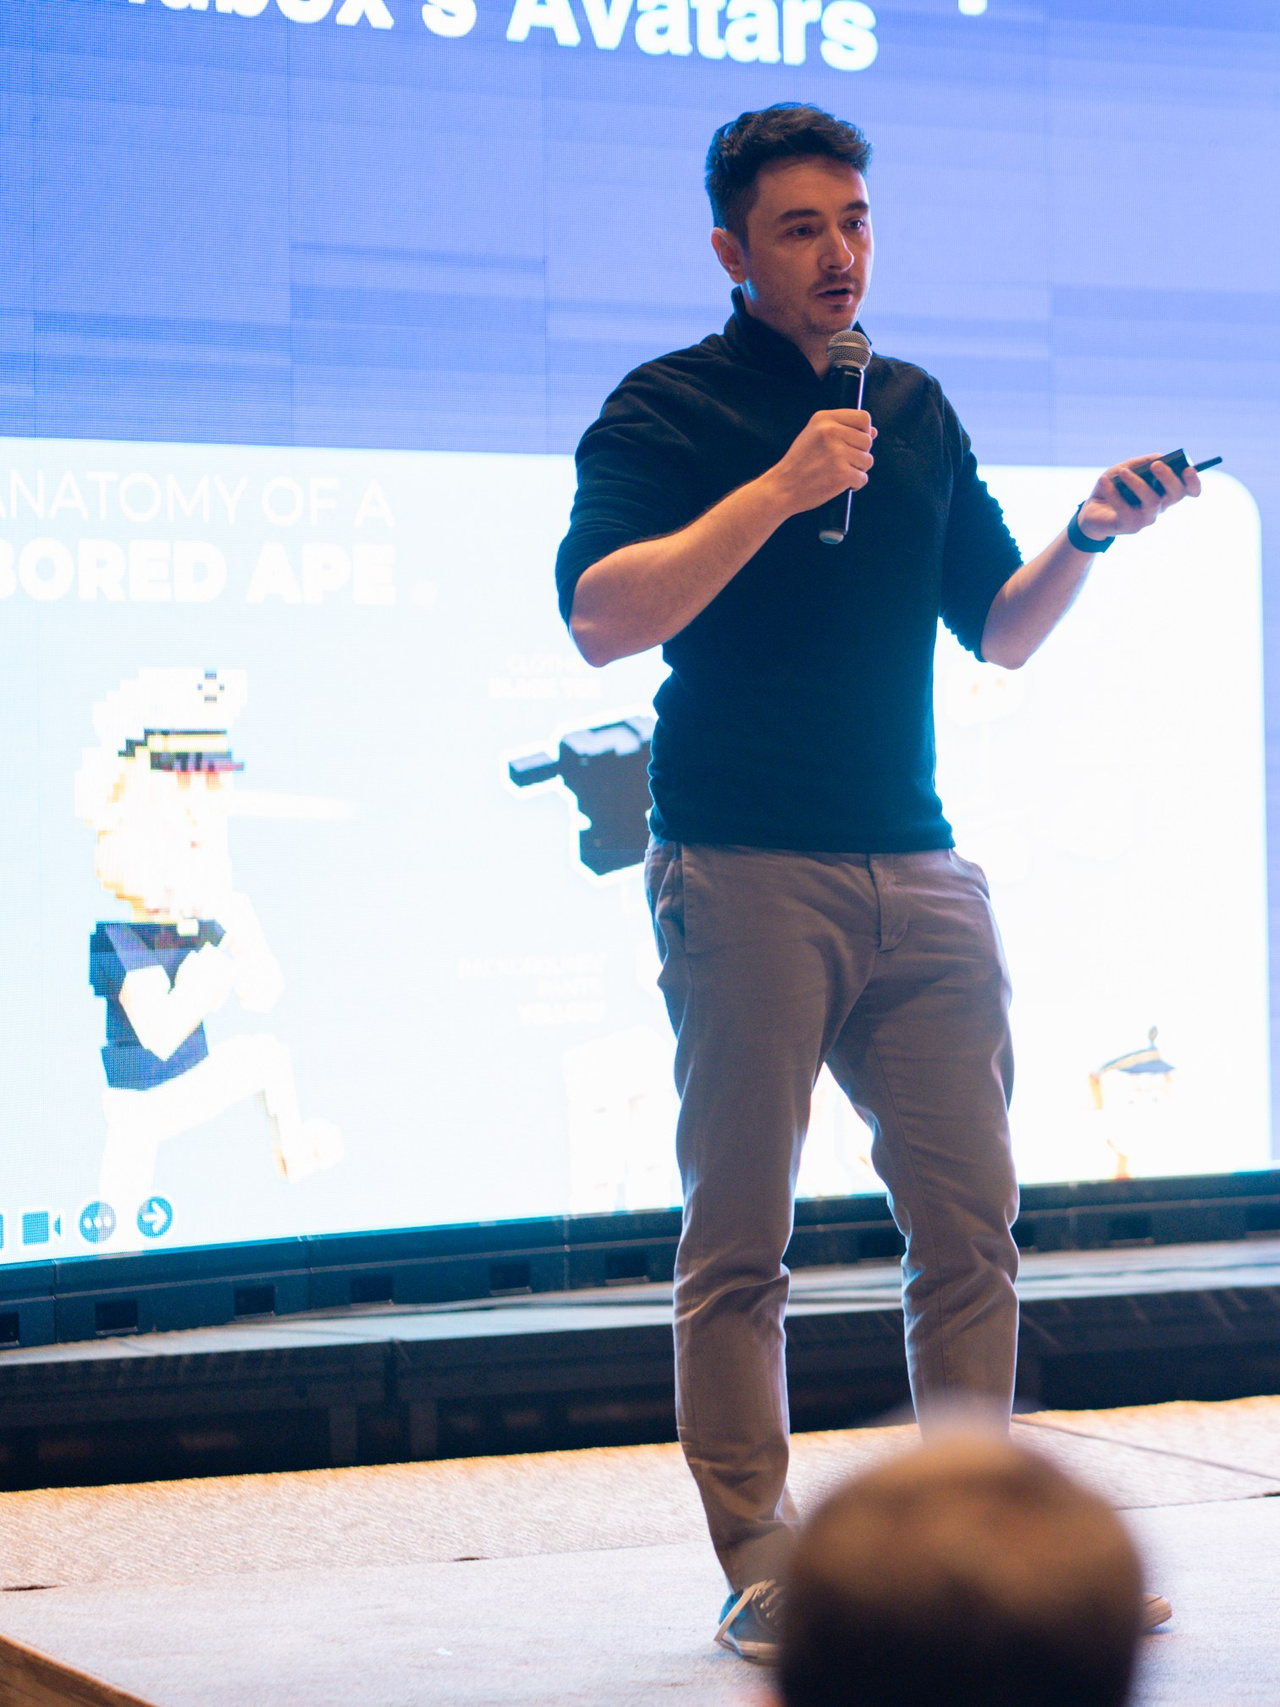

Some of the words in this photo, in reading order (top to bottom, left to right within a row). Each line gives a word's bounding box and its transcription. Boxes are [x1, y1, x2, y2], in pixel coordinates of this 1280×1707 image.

[0, 469, 249, 526] NATOMY
[261, 475, 341, 528] OF
[352, 478, 397, 529] A
[245, 541, 398, 606] APE
